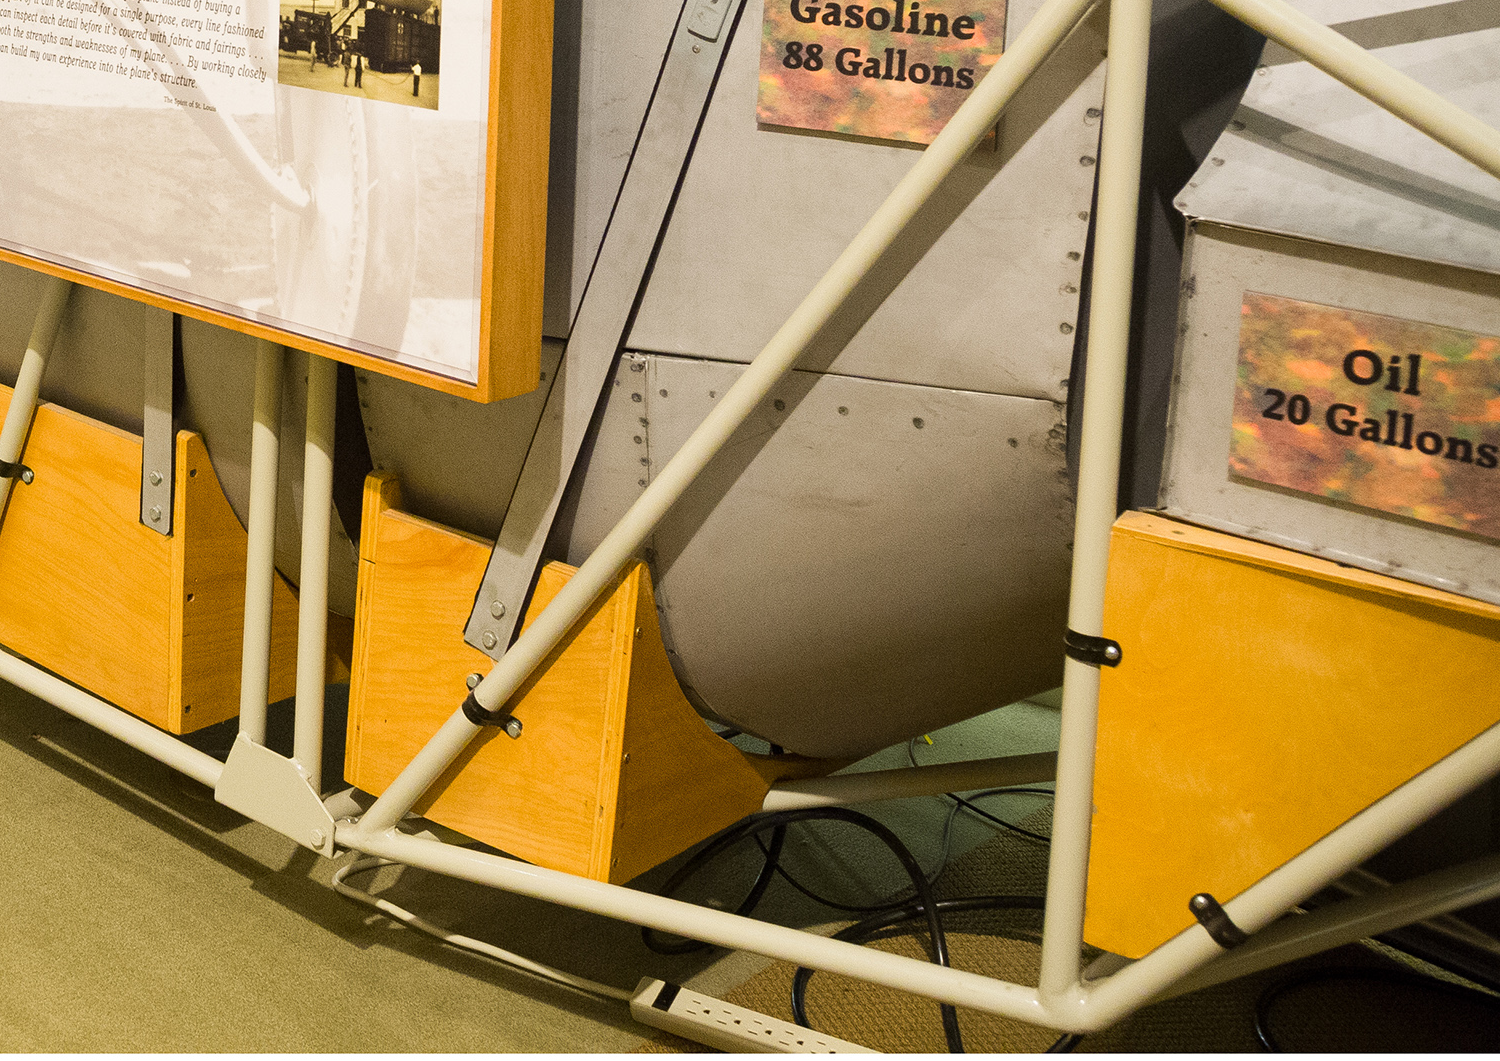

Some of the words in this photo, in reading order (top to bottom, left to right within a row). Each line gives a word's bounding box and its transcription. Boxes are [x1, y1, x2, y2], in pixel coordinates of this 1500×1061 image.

[0, 8, 11, 18] can
[14, 9, 37, 24] inspect
[40, 12, 55, 26] each
[58, 15, 78, 29] detail
[80, 18, 101, 33] before
[119, 26, 147, 40] covered
[150, 31, 166, 44] with
[168, 33, 192, 48] fabric
[195, 37, 210, 51] and
[212, 40, 246, 57] fairings
[98, 2, 110, 16] for
[113, 8, 118, 16] a
[120, 7, 142, 20] single
[145, 11, 178, 27] purpose,
[181, 17, 203, 31] every
[205, 18, 220, 32] line
[223, 21, 265, 39] fashioned
[235, 6, 240, 15] a
[11, 42, 28, 58] build
[29, 49, 40, 62] my
[42, 52, 57, 63] own
[59, 55, 97, 70] experience
[99, 60, 114, 73] into
[116, 62, 127, 76] the
[130, 65, 157, 82] plane's
[160, 72, 198, 88] structure.
[13, 26, 24, 38] the
[26, 29, 58, 45] strengths
[60, 35, 72, 48] and
[75, 37, 117, 55] weaknesses
[120, 45, 128, 57] of
[130, 48, 141, 60] my
[187, 55, 198, 71] By
[202, 60, 235, 77] working
[238, 64, 267, 83] closely
[782, 41, 823, 71] 88
[835, 47, 975, 90] Gallons
[1342, 350, 1421, 396] Oil
[1262, 388, 1311, 425] 20
[1325, 402, 1499, 469] Gallons
